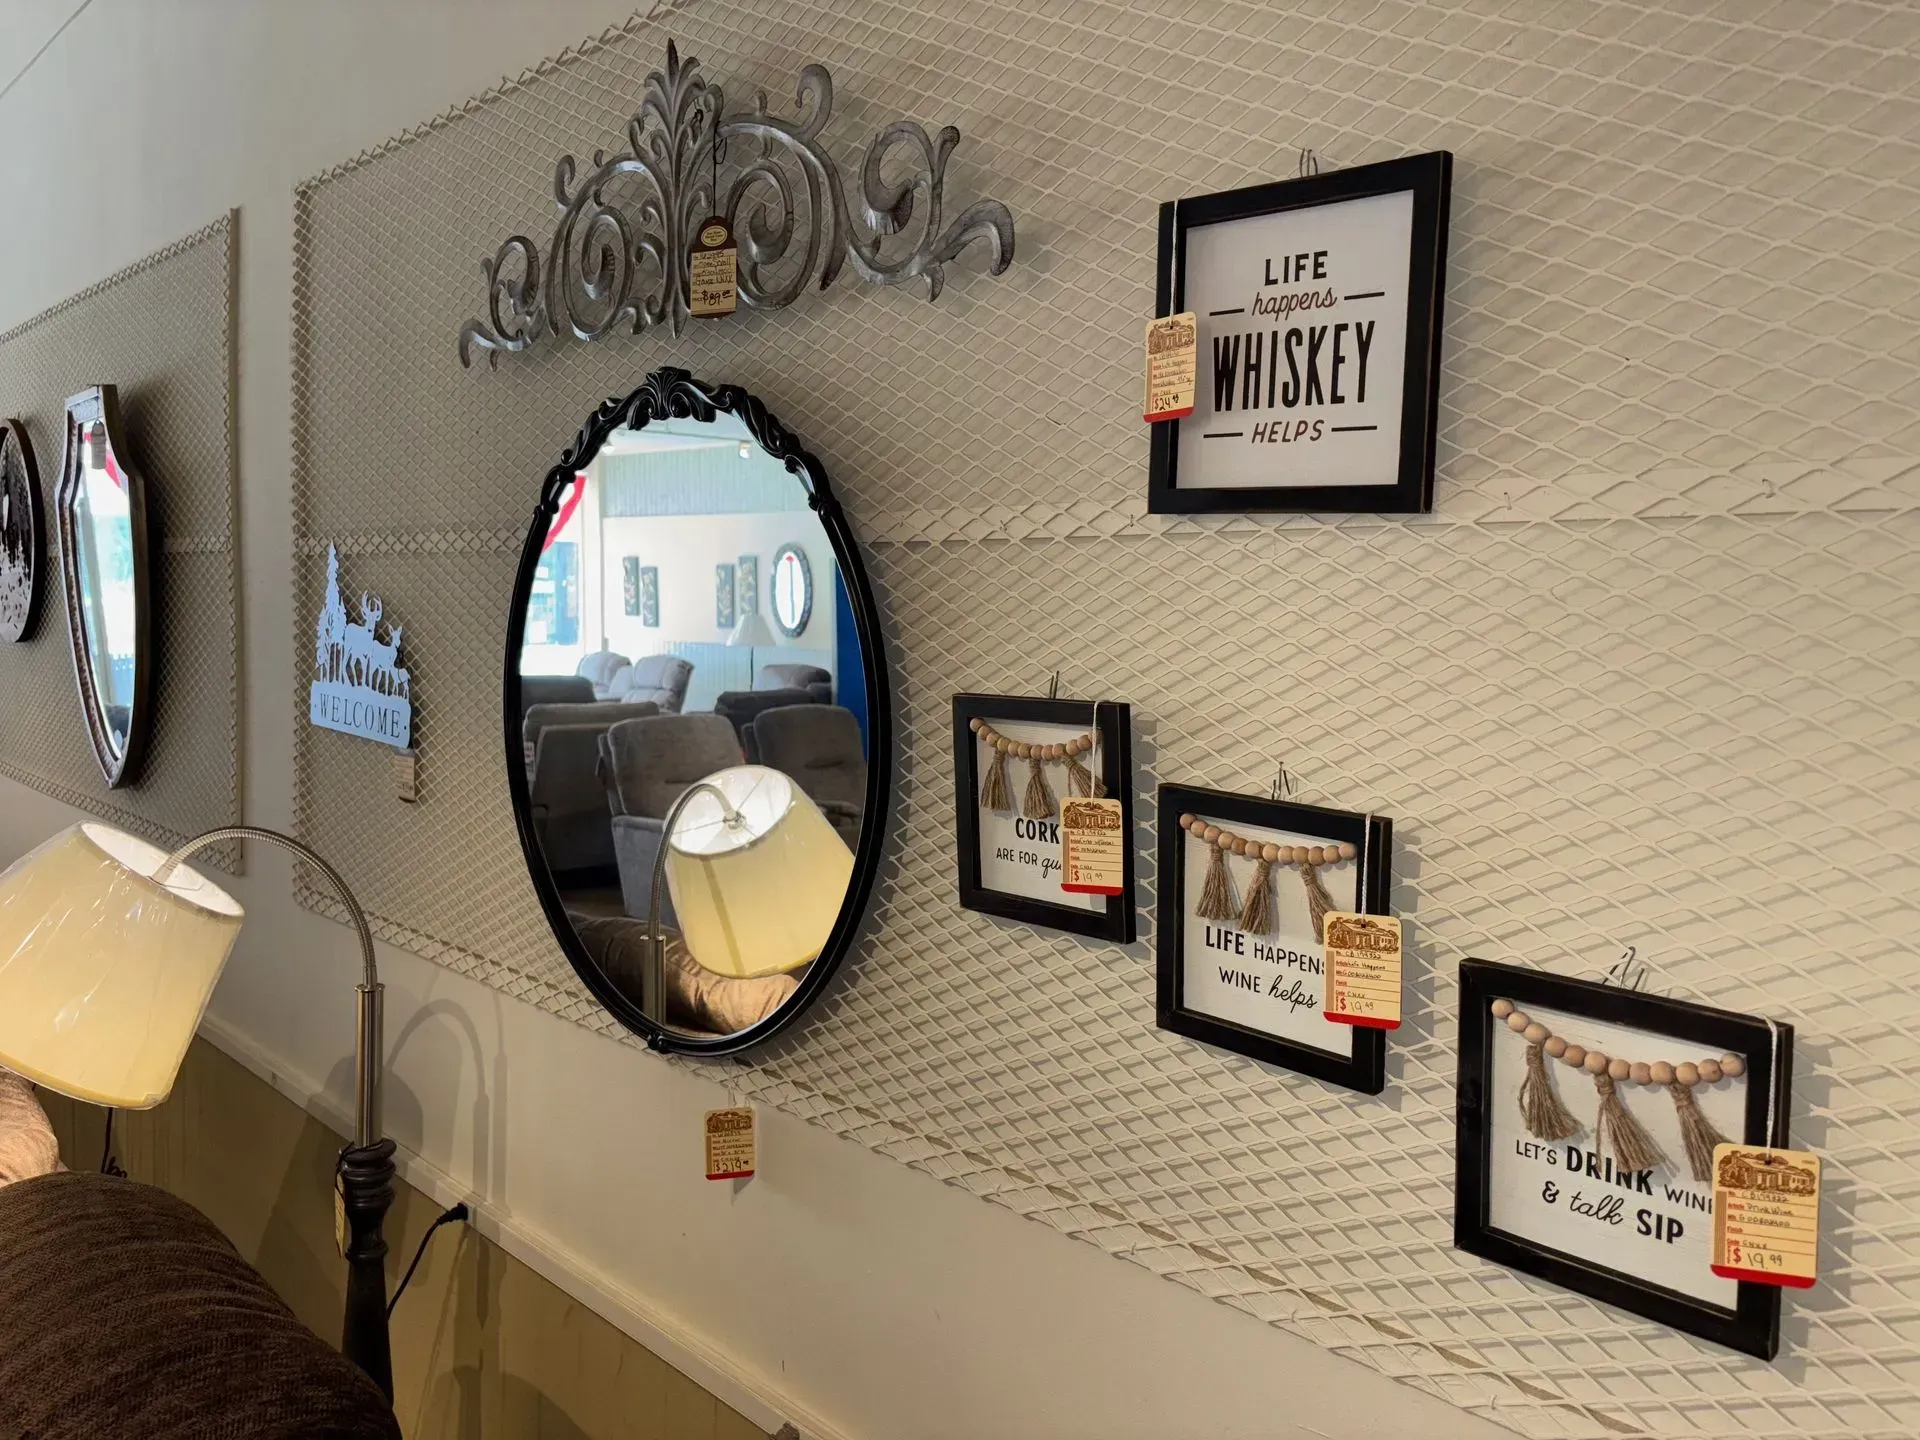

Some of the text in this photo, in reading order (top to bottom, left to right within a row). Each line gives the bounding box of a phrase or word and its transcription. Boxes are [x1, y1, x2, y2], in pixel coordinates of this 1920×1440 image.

[1264, 250, 1328, 286] LIFE
[1251, 286, 1338, 322] happens
[1213, 320, 1375, 412] WHISKEY
[1252, 420, 1325, 444] HELPS
[320, 693, 401, 739] WELCOME
[996, 847, 1015, 863] ARE
[1019, 851, 1038, 867] FOR
[1205, 925, 1245, 956] LIFE
[1218, 966, 1318, 1014] WINE helps
[1516, 1139, 1557, 1166] LET'S
[1566, 1145, 1655, 1197] DRINK
[1542, 1180, 1685, 1245] & talk SIP
